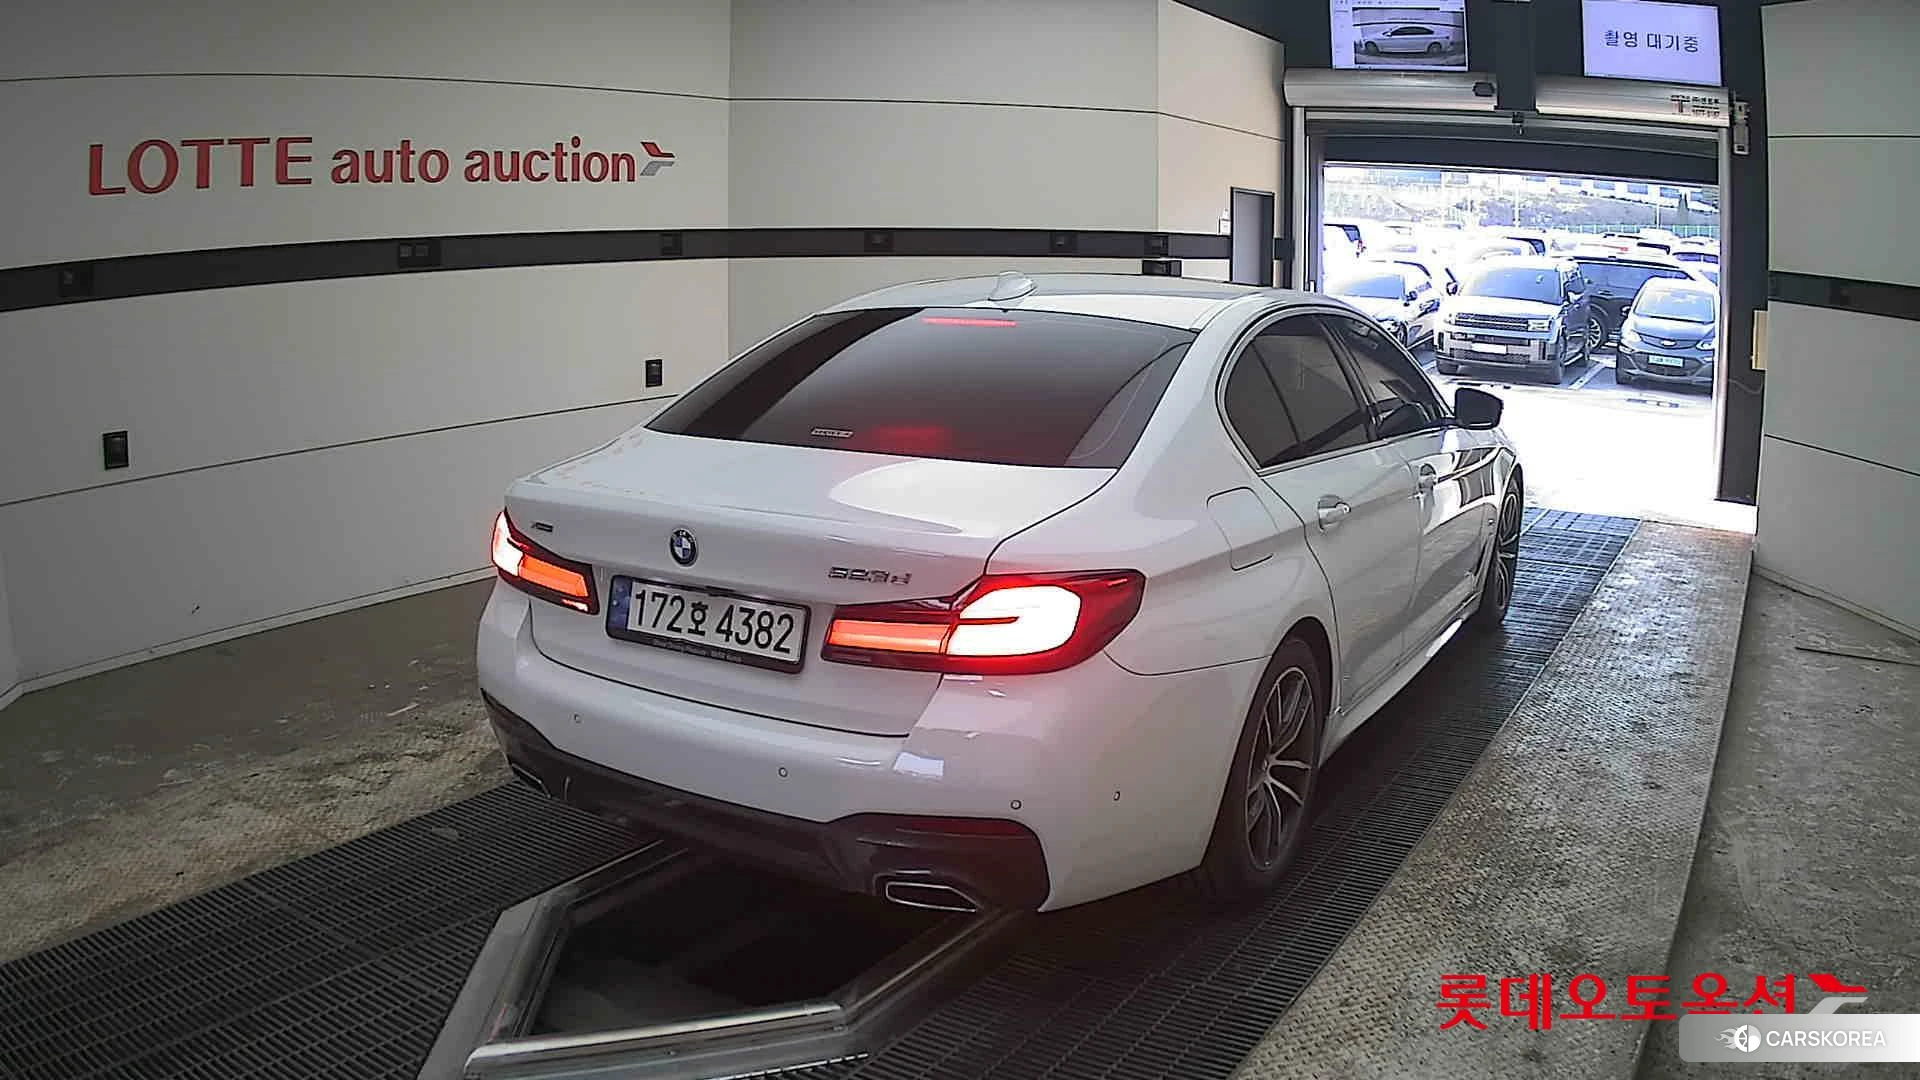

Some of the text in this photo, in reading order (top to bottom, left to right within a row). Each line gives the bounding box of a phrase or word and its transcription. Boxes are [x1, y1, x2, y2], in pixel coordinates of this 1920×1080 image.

[1646, 32, 1699, 53] 대기중
[89, 135, 636, 196] LOTTE auto auction
[635, 588, 709, 637] 172호
[715, 604, 795, 655] 4382
